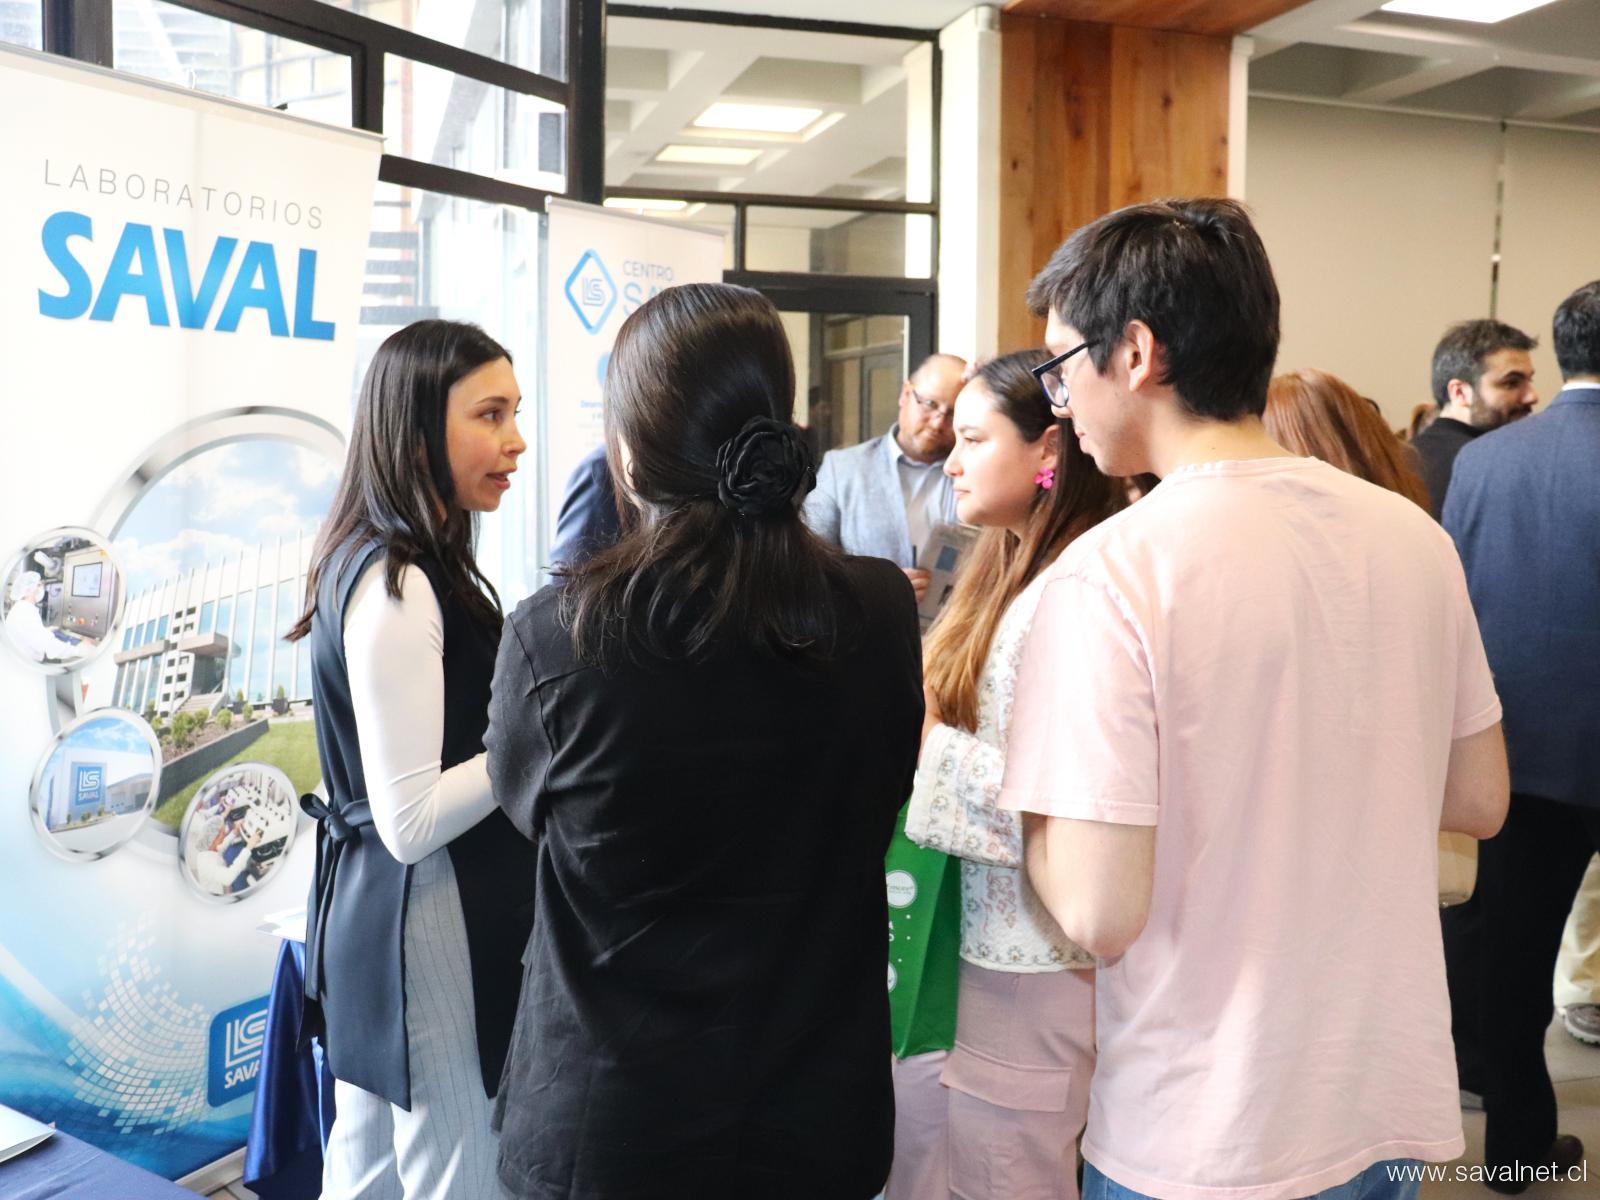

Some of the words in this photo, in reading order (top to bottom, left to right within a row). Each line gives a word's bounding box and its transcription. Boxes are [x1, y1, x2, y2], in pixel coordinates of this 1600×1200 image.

[44, 159, 323, 229] LABORATORIOS
[38, 211, 336, 341] SAVAL
[623, 260, 674, 282] CENTRO
